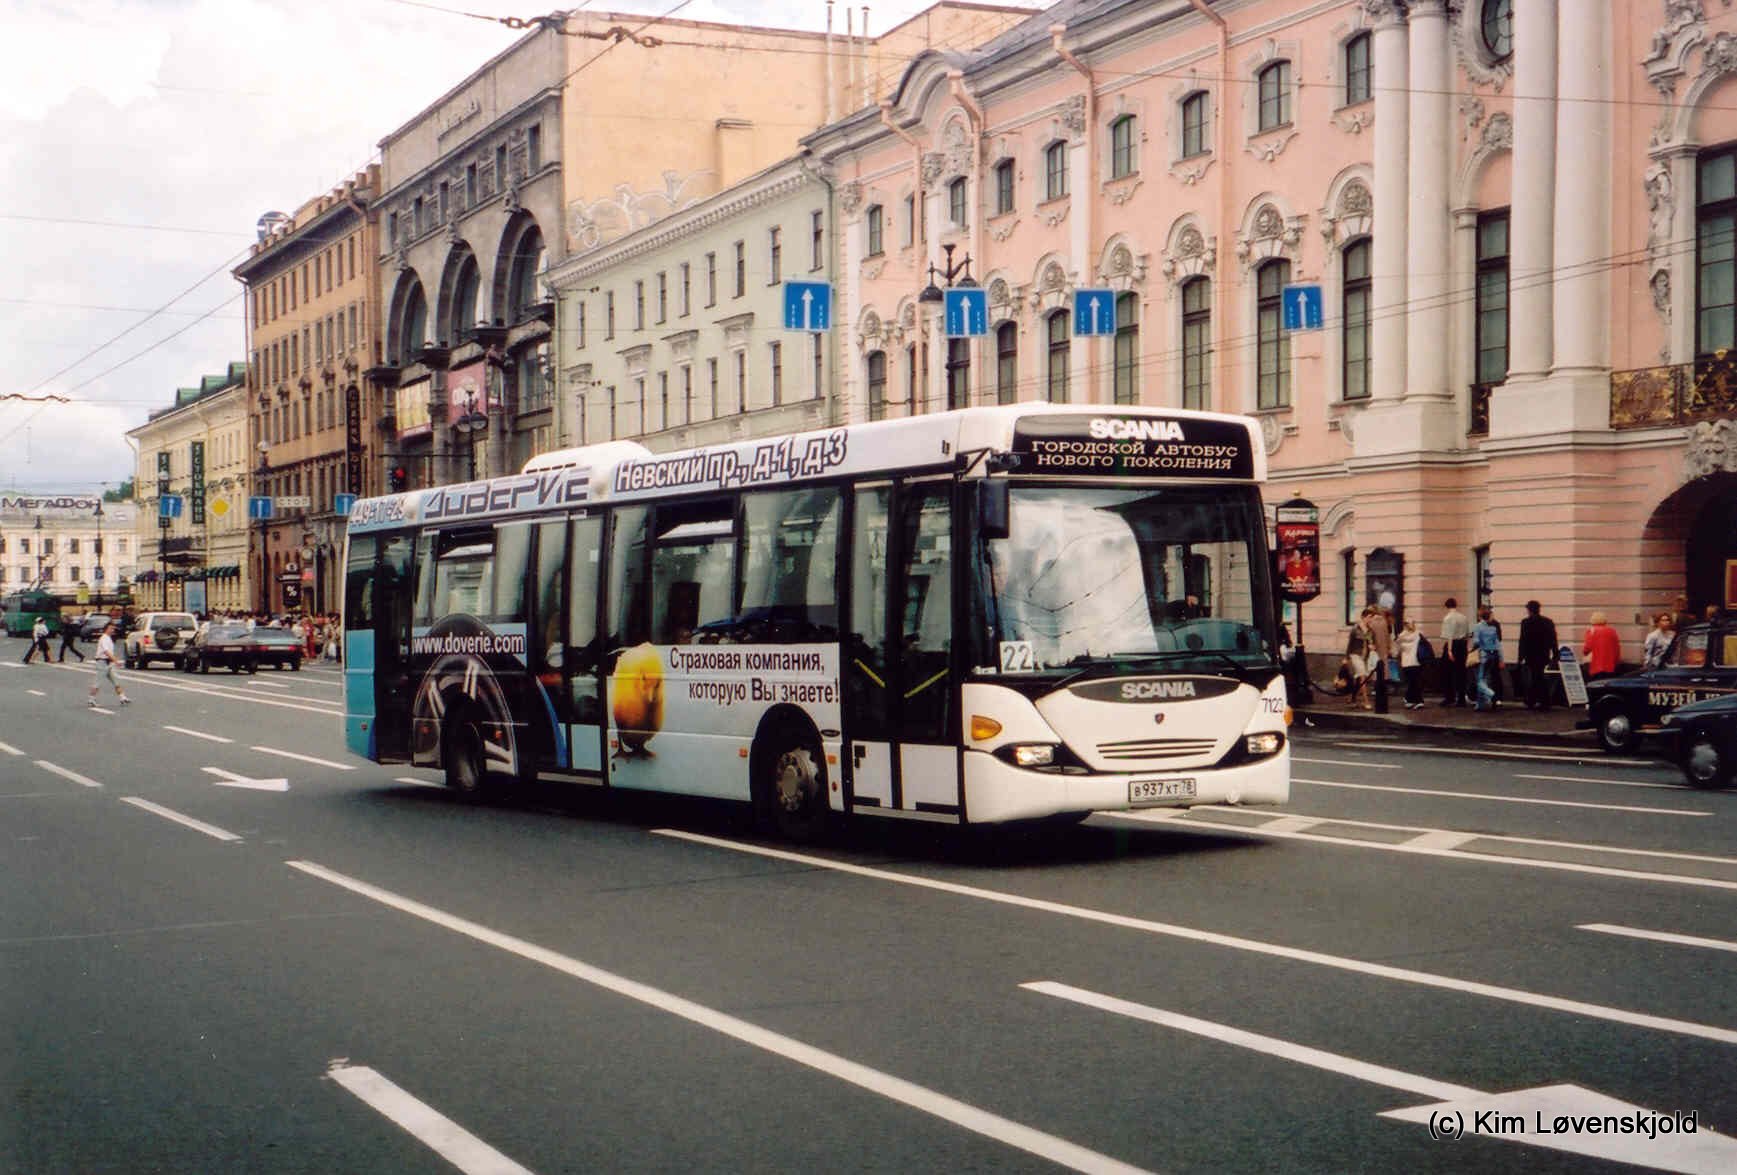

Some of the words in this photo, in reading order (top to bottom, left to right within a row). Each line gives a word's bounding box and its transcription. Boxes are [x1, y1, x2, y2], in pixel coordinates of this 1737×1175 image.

[1089, 418, 1185, 441] SCANIA
[1031, 441, 1145, 455] ГОРОДСКОЙ
[1155, 444, 1239, 458] АВТОБУС
[614, 450, 705, 493] Невский
[1037, 454, 1115, 467] НОВОГО
[1123, 457, 1232, 470] ПОКОЛЕНИЯ
[413, 631, 525, 654] www.doverie.com
[670, 647, 742, 676] Страховая
[746, 650, 825, 675] компания,
[1003, 644, 1033, 671] 22
[689, 679, 746, 706] которую
[752, 677, 776, 701] Вы
[781, 678, 840, 704] знаете!
[1121, 681, 1196, 699] SCANIA
